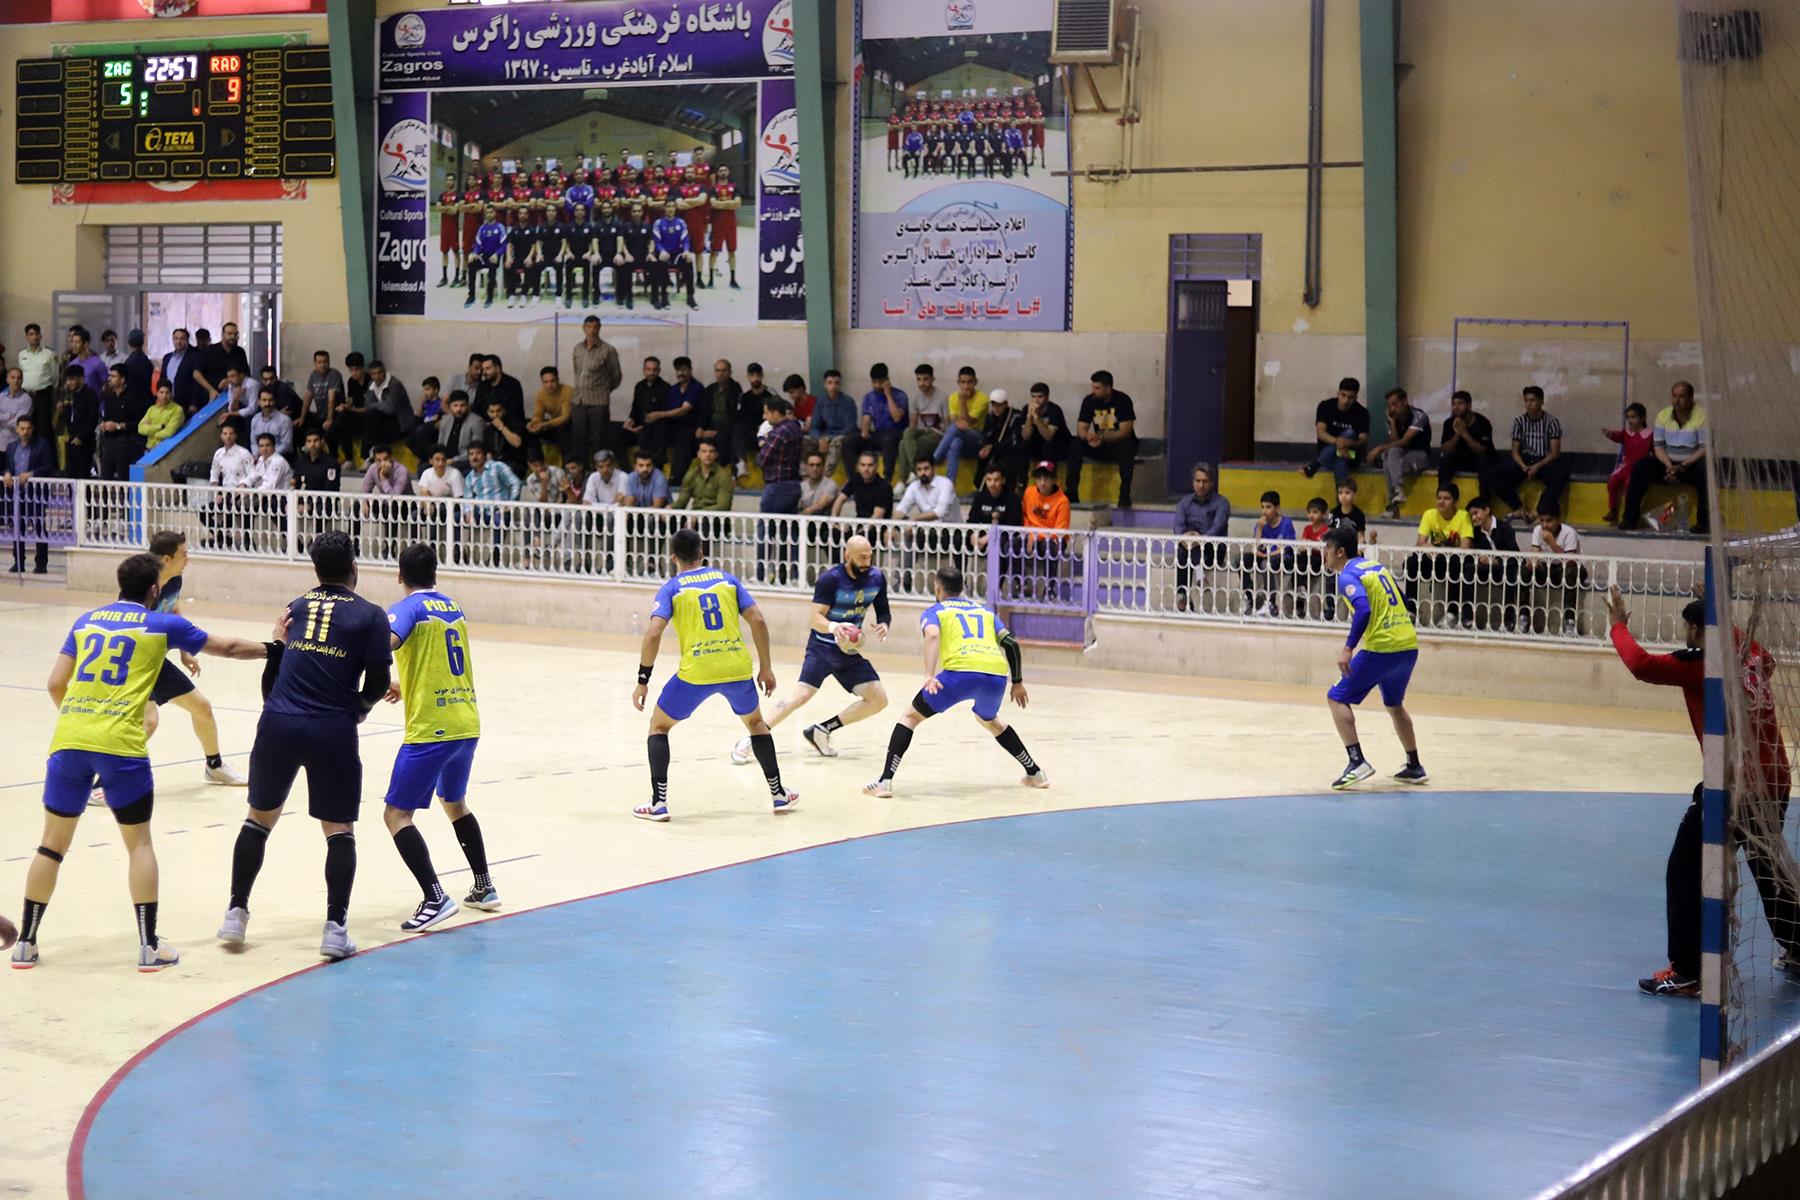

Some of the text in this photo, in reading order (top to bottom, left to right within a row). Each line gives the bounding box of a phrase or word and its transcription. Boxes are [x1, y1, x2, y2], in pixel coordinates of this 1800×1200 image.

[452, 2, 751, 51] باشگاه فرهنگی ورزشی زاگرس
[104, 62, 132, 77] ZAG
[144, 56, 198, 82] 22:57
[211, 57, 240, 72] RAD
[382, 60, 444, 74] Zagros
[658, 53, 693, 78] اسلام
[120, 82, 132, 106] 5
[227, 78, 241, 102] 9
[164, 131, 195, 145] TETA
[380, 209, 425, 222] Cultural Sports
[760, 206, 784, 222] ورزشی
[934, 221, 957, 232] همه
[959, 218, 1001, 235] حمایت
[1004, 217, 1026, 234] اعلام
[958, 247, 1003, 264] هواداران
[1005, 245, 1037, 263] کانون
[381, 280, 418, 292] Islamabad
[960, 274, 979, 292] کادر
[1378, 574, 1399, 606] 9
[123, 612, 147, 624] ALI
[698, 593, 724, 631] 8
[304, 601, 336, 642] 11
[955, 613, 984, 639] 17
[76, 633, 137, 686] 23
[444, 628, 465, 677] 6
